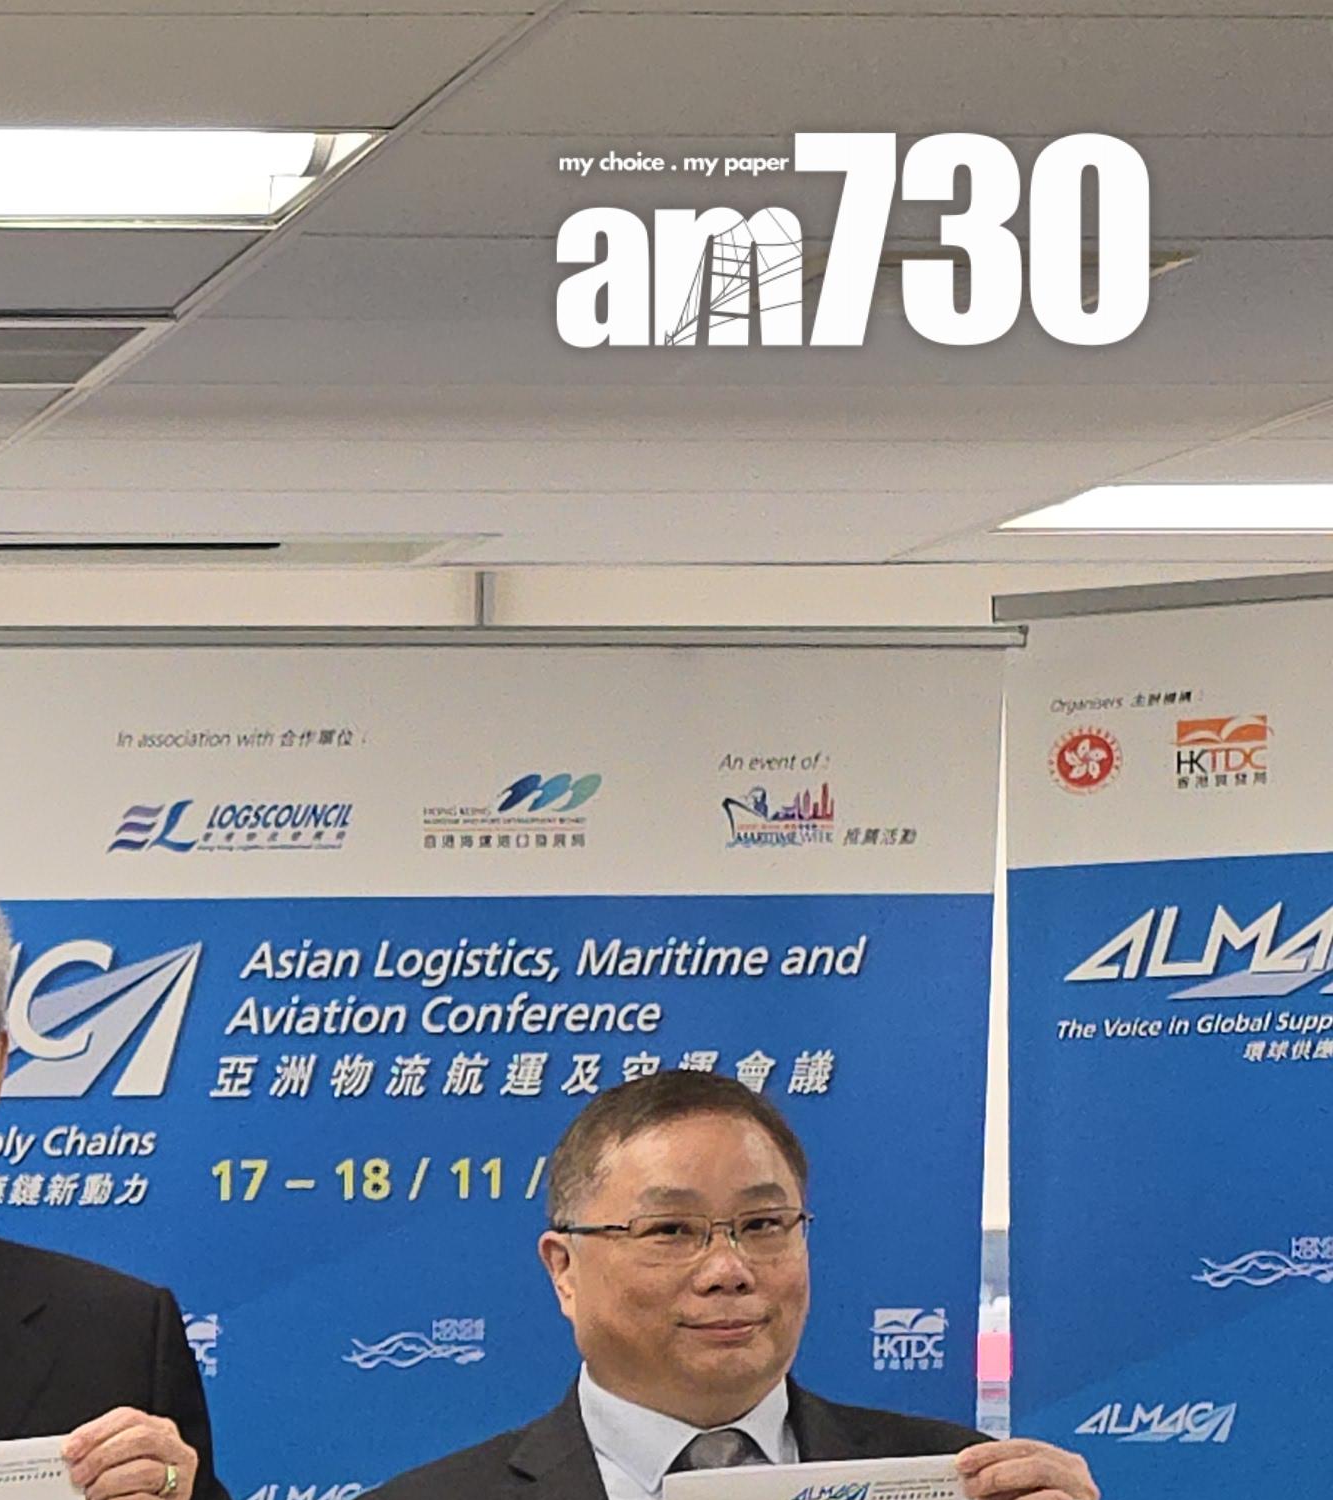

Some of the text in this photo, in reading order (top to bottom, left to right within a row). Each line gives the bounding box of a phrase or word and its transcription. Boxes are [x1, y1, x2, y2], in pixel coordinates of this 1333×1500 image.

[1051, 695, 1124, 715] Organisers
[117, 730, 132, 748] In
[137, 730, 231, 749] association
[236, 730, 274, 748] with
[719, 752, 820, 775] An event of
[1176, 746, 1267, 774] HKTDC
[206, 803, 353, 830] LOGSCOUNCIL
[240, 936, 868, 989] Asian Logistics, Maritime and
[1064, 902, 1333, 998] ALMA
[225, 994, 661, 1037] Aviation Conference
[1056, 1009, 1333, 1040] The Voice in Global Supp
[42, 1126, 157, 1159] Chains
[211, 1158, 269, 1202] 17
[335, 1158, 391, 1202] 18
[450, 1158, 503, 1201] 11
